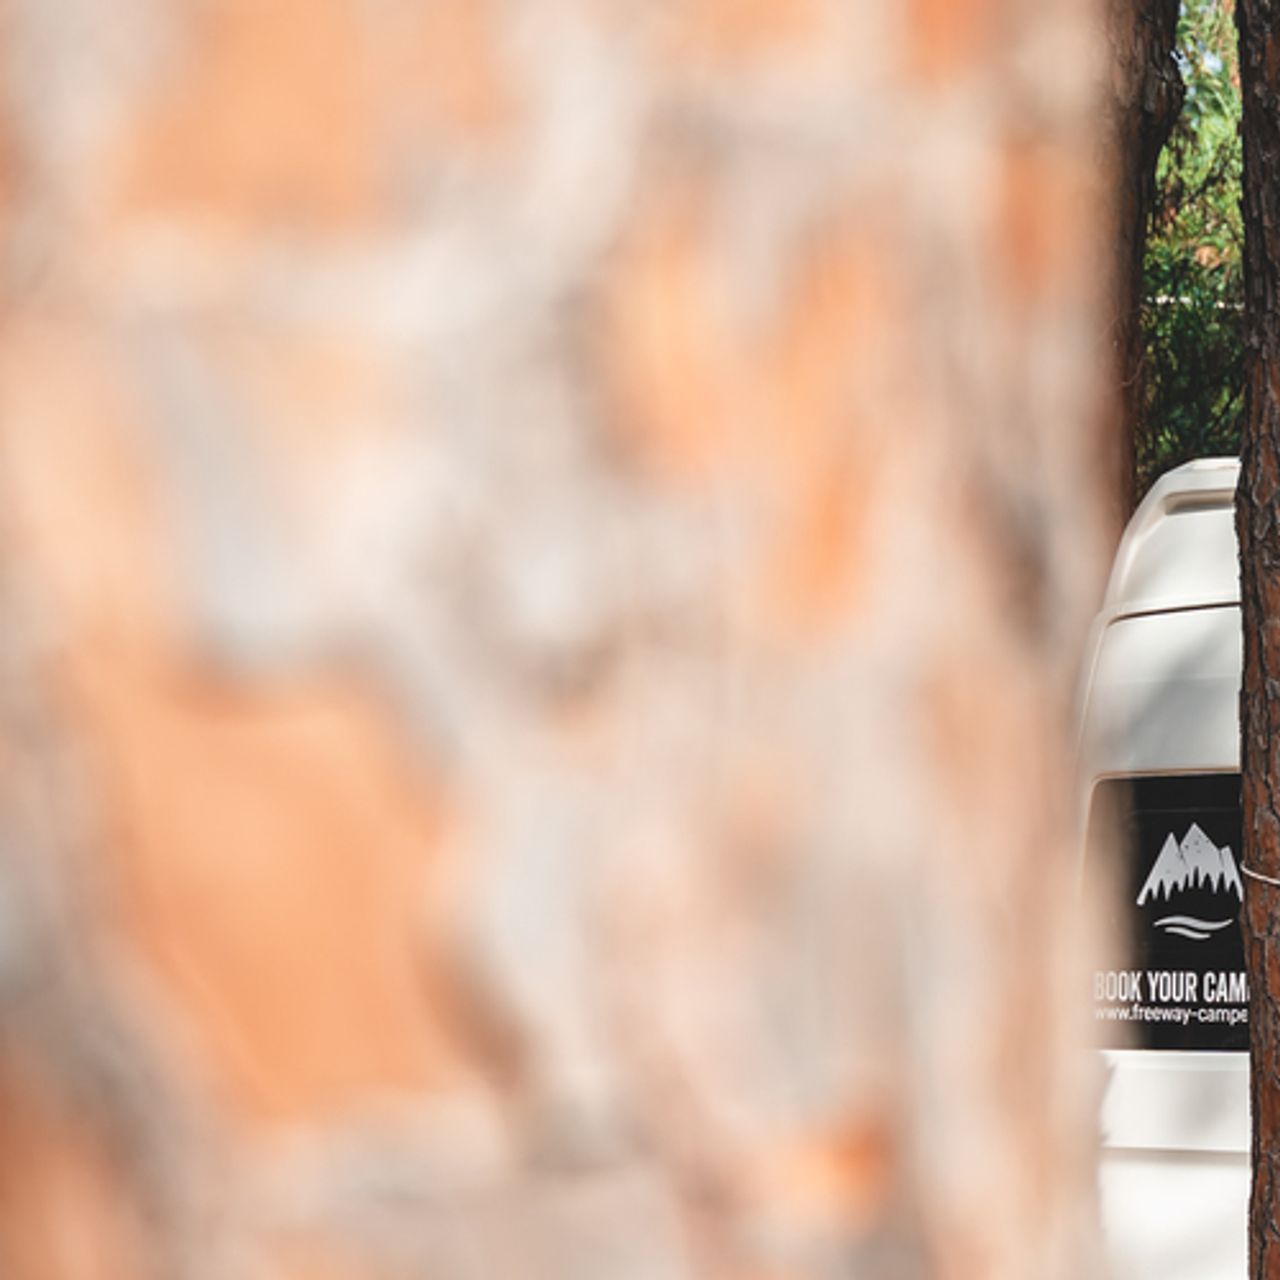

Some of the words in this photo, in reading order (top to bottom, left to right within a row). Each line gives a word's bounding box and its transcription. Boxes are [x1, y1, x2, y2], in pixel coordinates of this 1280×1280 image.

[1096, 970, 1142, 1002] BOOK
[1147, 970, 1198, 1003] YOUR
[1203, 971, 1250, 1003] CAM
